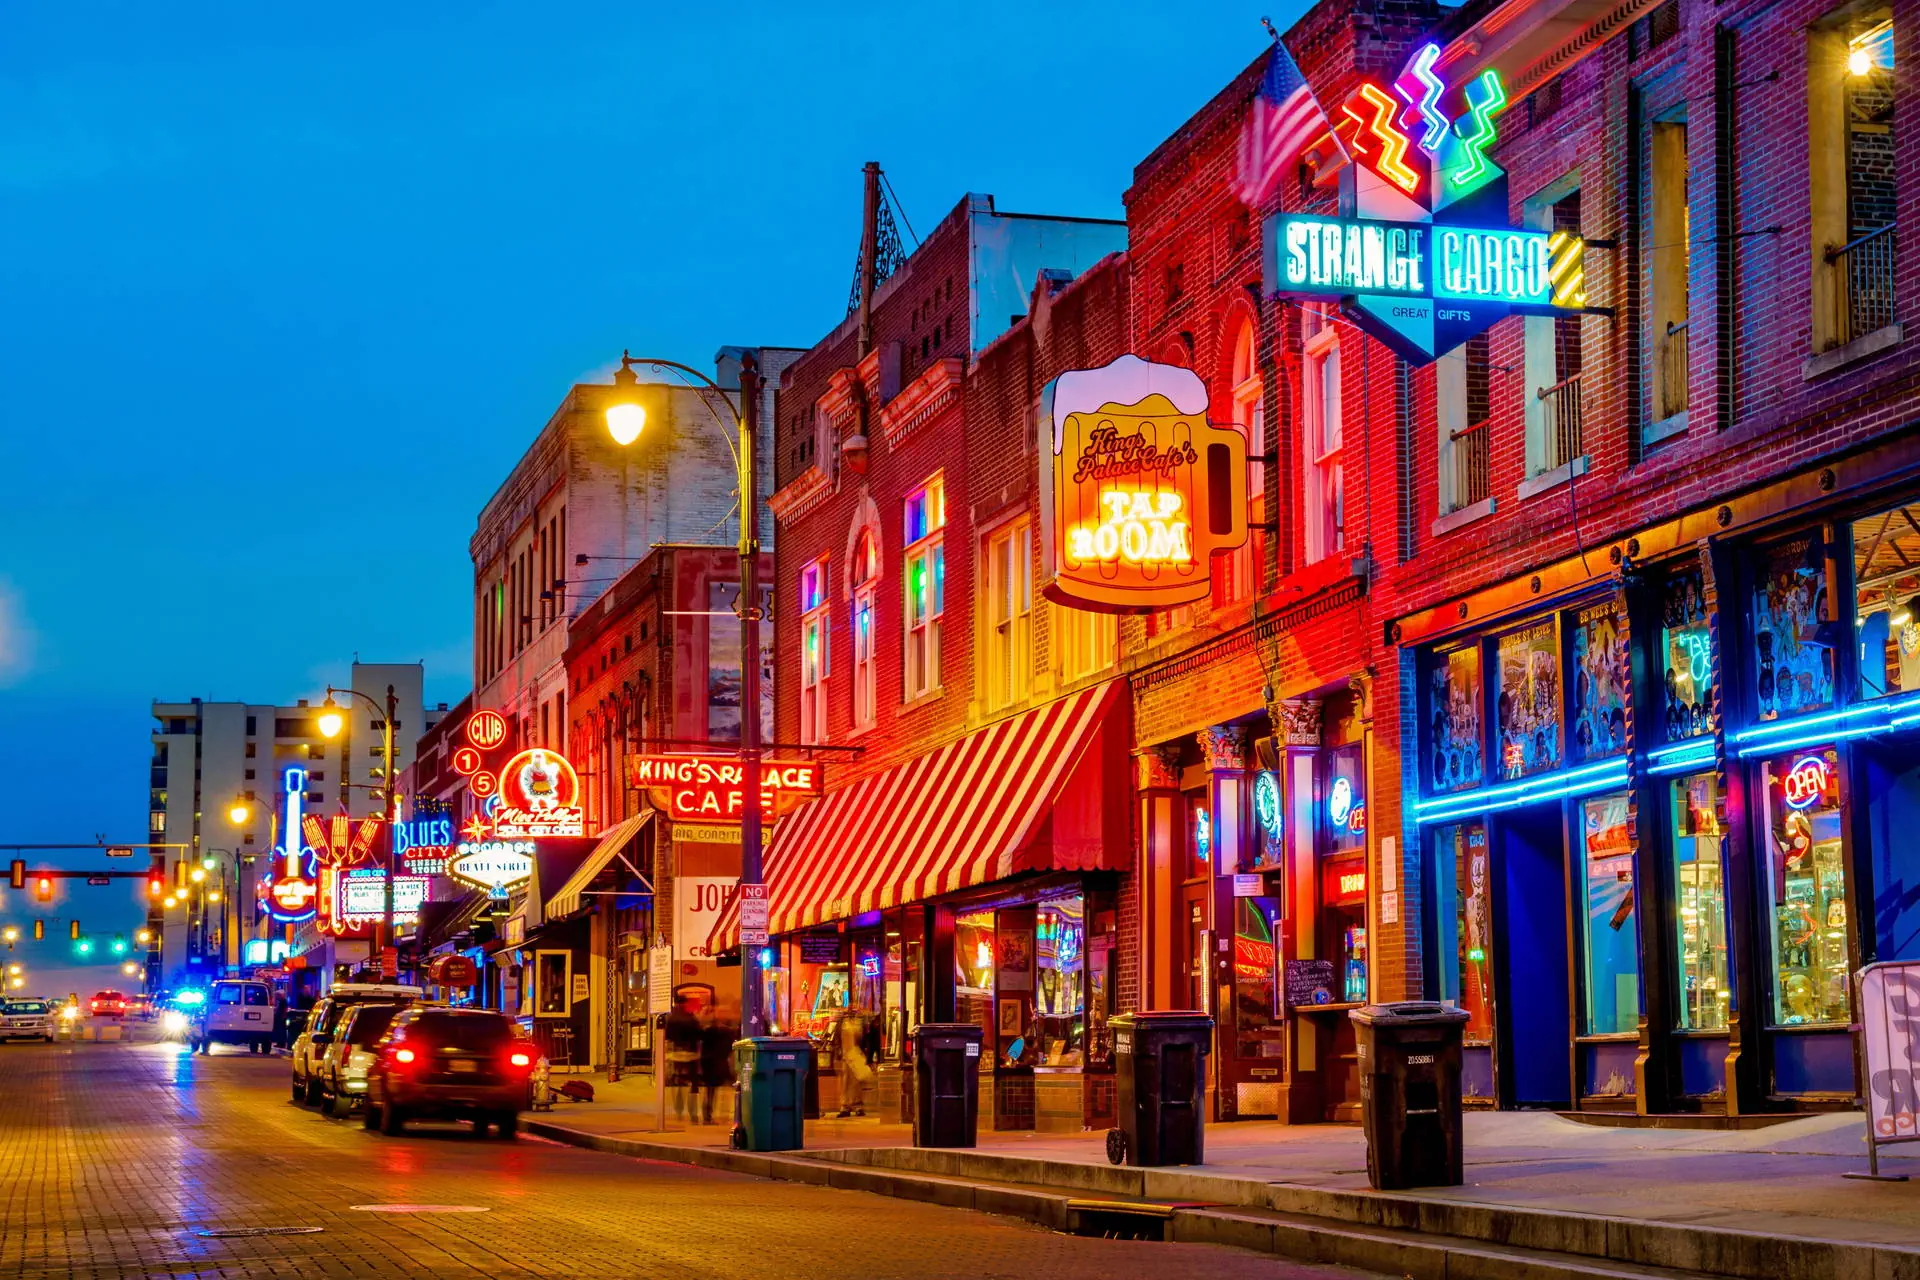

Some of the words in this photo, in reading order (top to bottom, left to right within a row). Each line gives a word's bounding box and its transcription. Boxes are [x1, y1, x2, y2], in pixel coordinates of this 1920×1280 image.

[1286, 221, 1424, 292] STRANGE
[1443, 231, 1546, 299] CARGO
[1392, 307, 1430, 319] GREAT
[1437, 309, 1471, 321] GIFTS
[1073, 453, 1141, 484] Palace
[1102, 491, 1182, 524] TAP
[1071, 520, 1191, 561] ROOM
[471, 716, 503, 744] CLUB
[462, 753, 471, 769] 1
[639, 759, 710, 784] KING'S
[477, 776, 490, 792] 5
[1785, 764, 1827, 801] OPEN
[676, 790, 774, 814] CAFE
[1349, 808, 1365, 829] OPE
[393, 820, 450, 854] BLUES
[675, 828, 693, 840] AIR
[698, 829, 768, 842] CONDITID
[405, 846, 449, 858] CITY
[411, 866, 443, 874] STORE
[496, 861, 527, 871] STREE
[745, 887, 763, 897] NO
